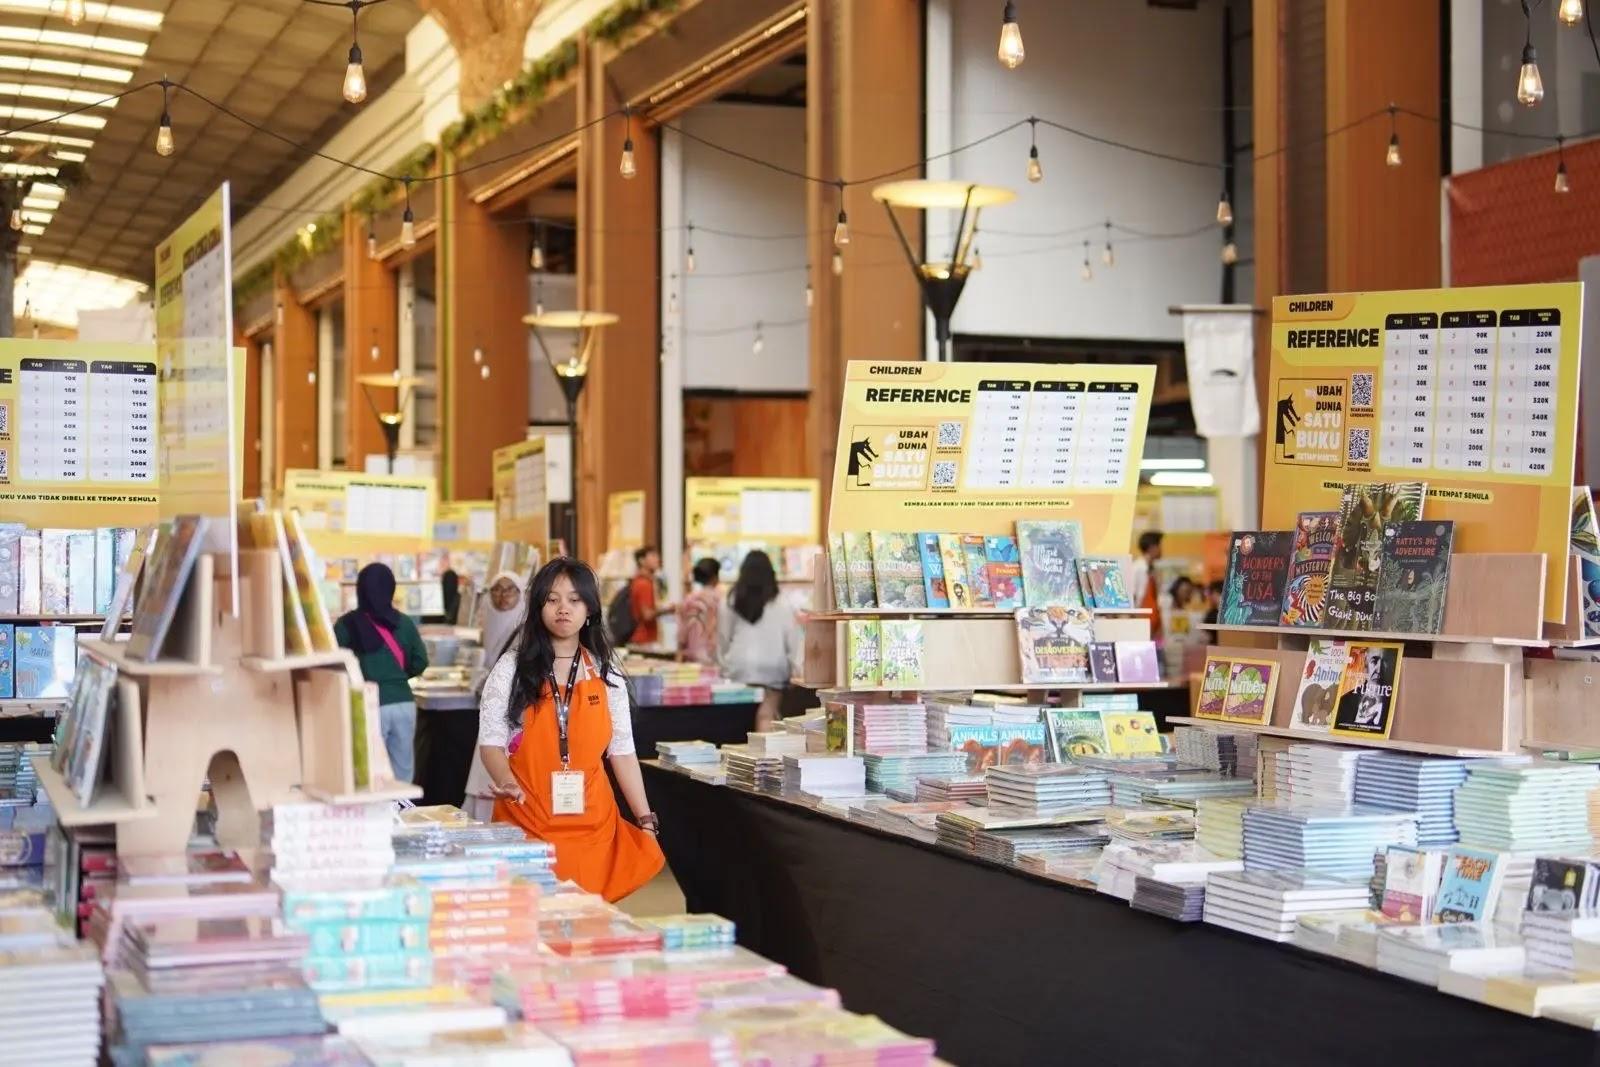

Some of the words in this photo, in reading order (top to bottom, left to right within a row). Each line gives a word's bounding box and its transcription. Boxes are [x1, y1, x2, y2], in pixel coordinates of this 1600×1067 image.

[1289, 300, 1333, 312] CHILDREN
[1288, 328, 1379, 348] REFERENCE
[869, 366, 922, 375] CHILDREN
[866, 388, 972, 403] REFERENCE
[1316, 386, 1342, 396] UBAH
[1316, 402, 1342, 411] DUNIA
[1303, 412, 1341, 428] SATU
[899, 430, 928, 438] UBAH
[1296, 430, 1340, 449] BUKU
[884, 450, 926, 462] SATU
[874, 464, 923, 478] BUKU
[1394, 547, 1436, 556] ADVENTURE
[1243, 556, 1284, 570] WONDERS
[1247, 582, 1274, 600] USA
[1330, 590, 1344, 600] The
[1348, 591, 1361, 605] Big
[1328, 606, 1352, 620] Giant
[952, 730, 998, 741] ANIMALS
[1001, 729, 1043, 741] ANIMALS
